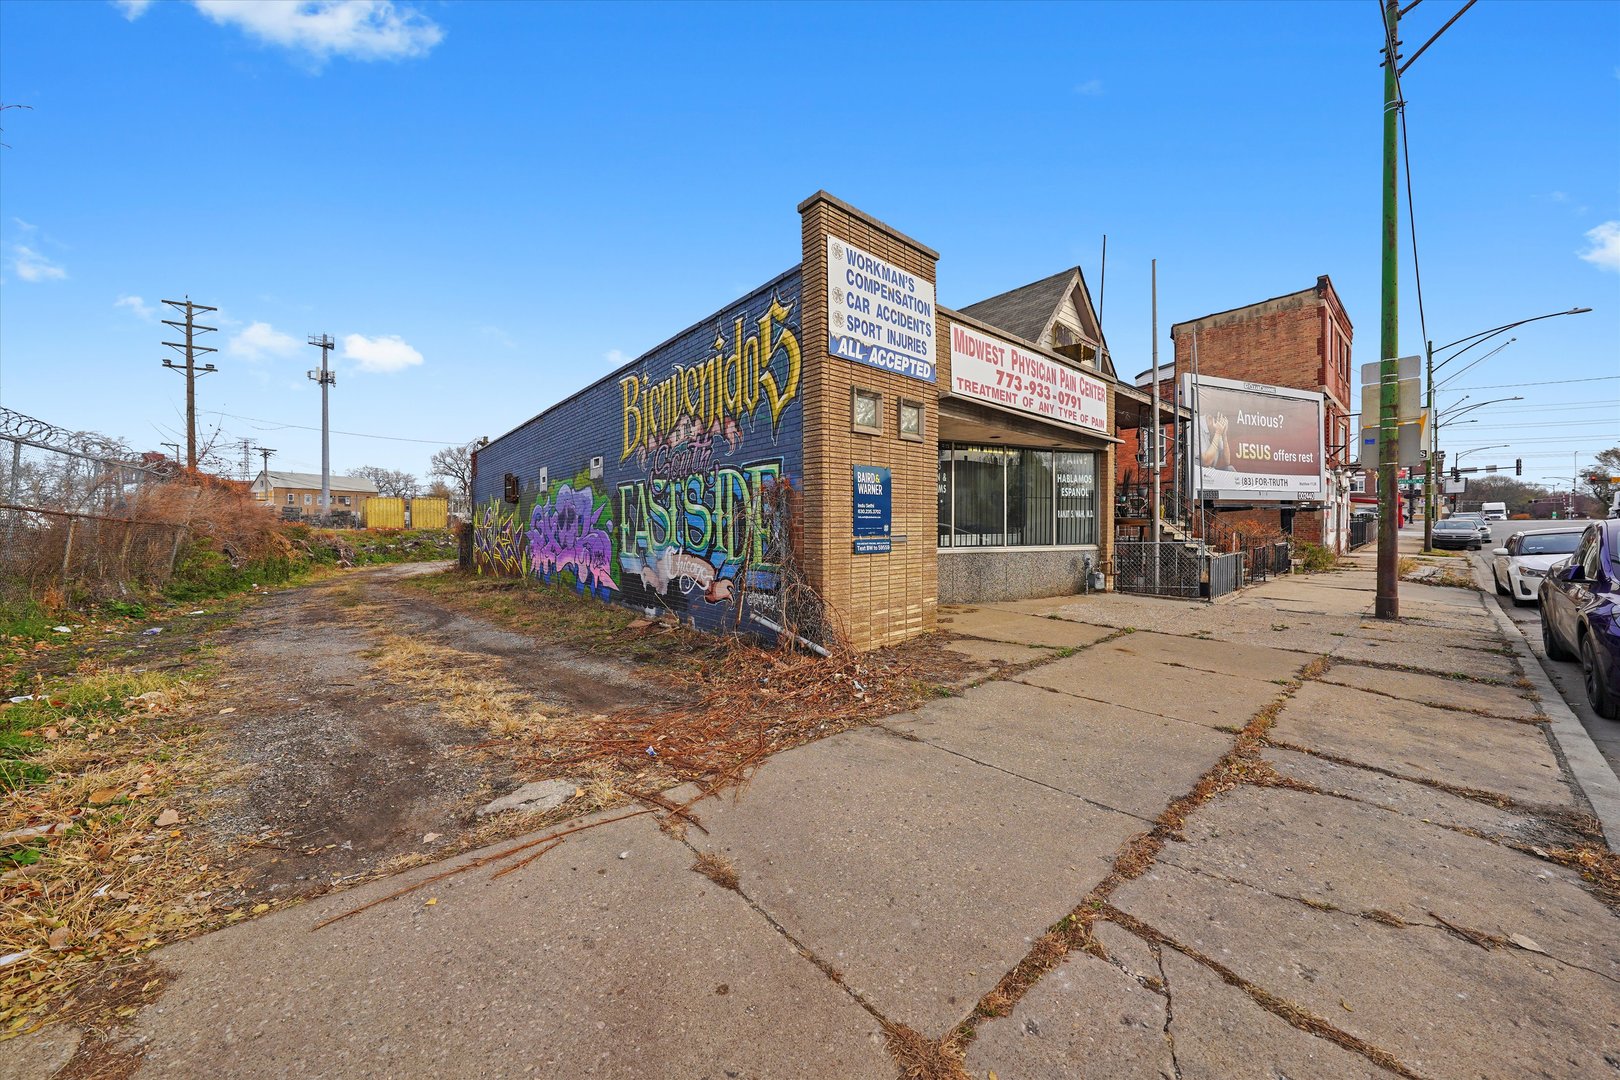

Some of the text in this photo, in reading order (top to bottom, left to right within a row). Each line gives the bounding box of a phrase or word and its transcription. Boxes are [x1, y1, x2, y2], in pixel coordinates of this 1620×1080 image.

[846, 247, 915, 293] WORKMAN'S
[846, 268, 931, 318] COMPENSATION
[846, 292, 932, 338] CAR ACCIDENTS
[846, 314, 928, 356] SPORT INJURIES
[836, 338, 931, 378] ALL ACCEPTED
[954, 326, 1106, 402] MIDWEST PHYSICIAN PAIN CENTER
[956, 377, 1105, 428] TREATMENT OF ANY TYPE OF PAIN
[1236, 410, 1284, 429] Anxious?
[1062, 454, 1087, 464] PAIN?
[1236, 442, 1314, 463] JESUS offers rest
[857, 472, 875, 484] BAIRD
[858, 483, 883, 496] WARNER
[1057, 474, 1092, 483] HABLAMOS
[1242, 478, 1288, 487] (83) FOR-TRUTH
[665, 546, 714, 594] Chicago
